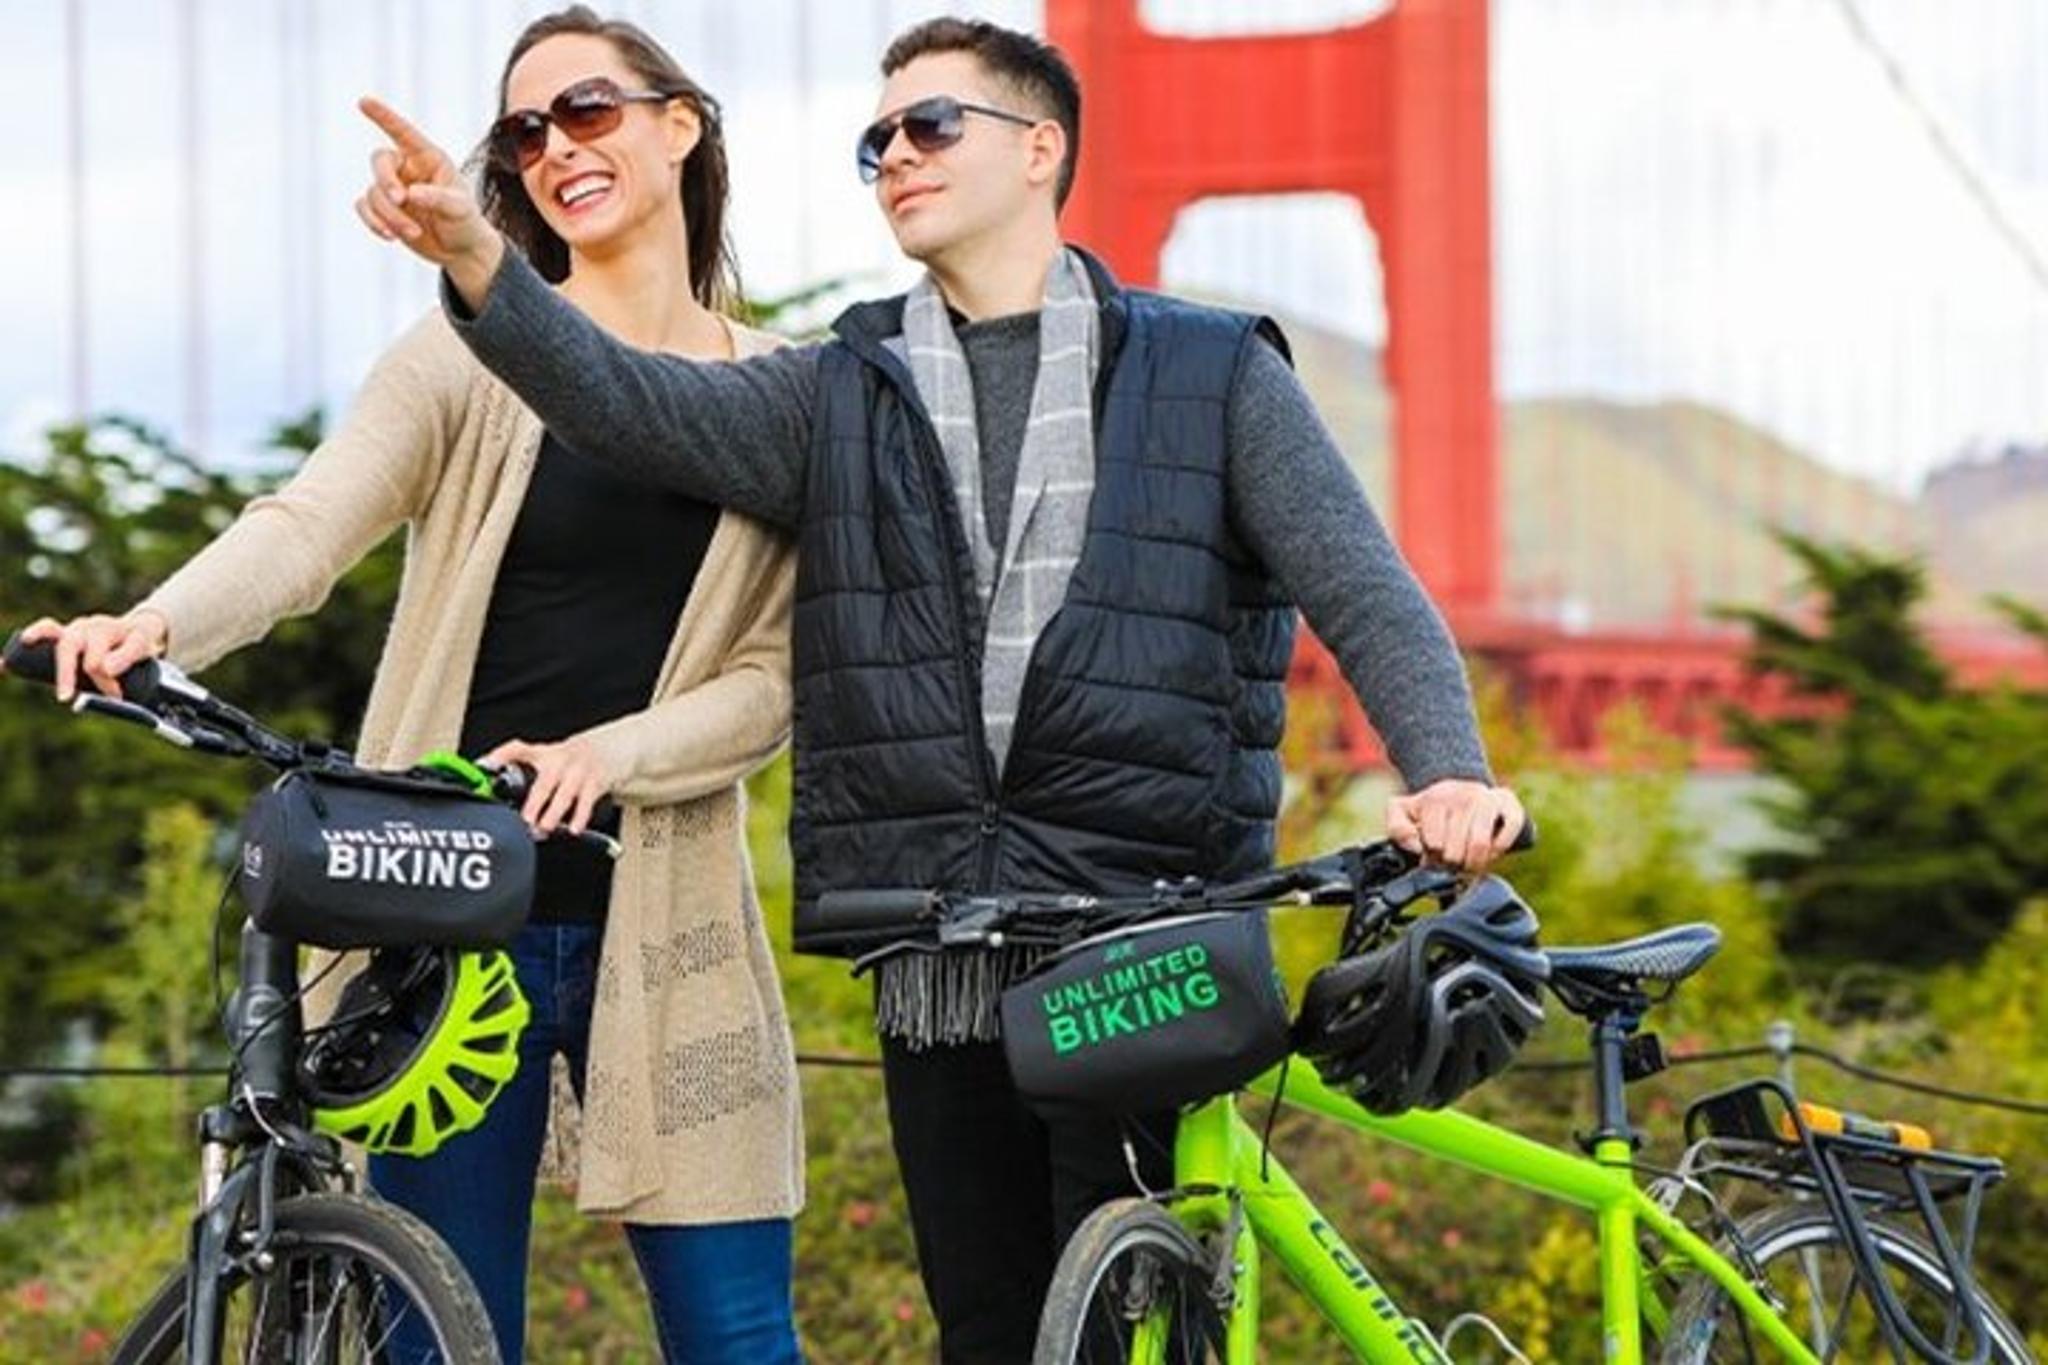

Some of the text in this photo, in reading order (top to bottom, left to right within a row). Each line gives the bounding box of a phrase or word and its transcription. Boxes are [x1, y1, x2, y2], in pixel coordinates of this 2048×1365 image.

[321, 829, 493, 850] UNLIMITED
[326, 843, 492, 890] BIKING
[1043, 943, 1207, 1015] UNLIMITED
[1049, 972, 1218, 1054] BIKING
